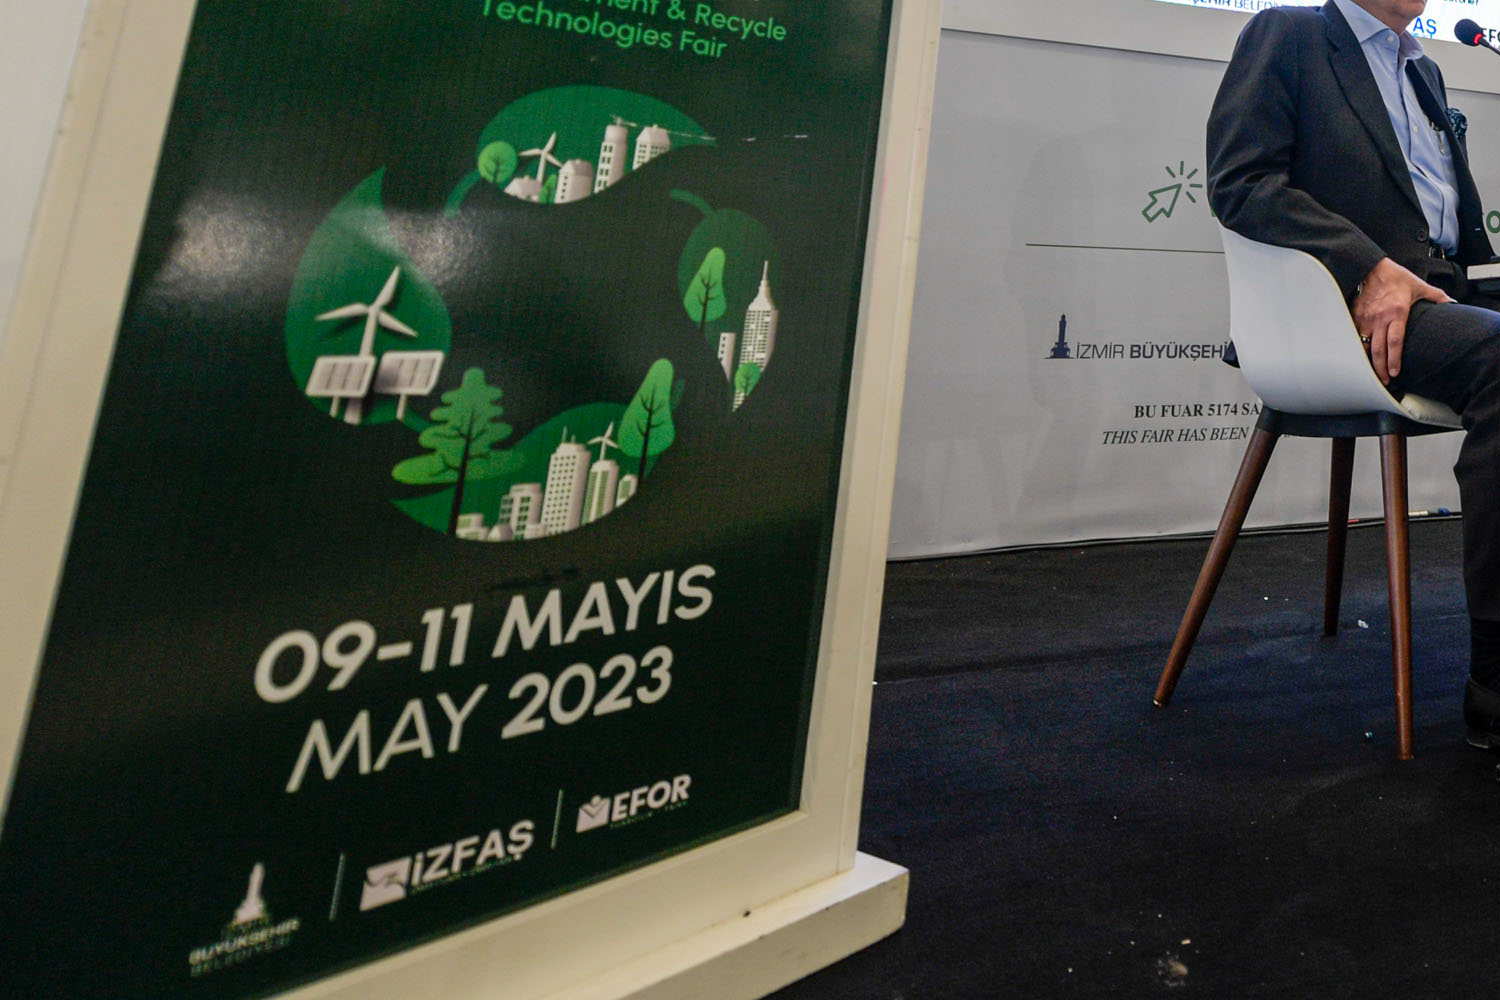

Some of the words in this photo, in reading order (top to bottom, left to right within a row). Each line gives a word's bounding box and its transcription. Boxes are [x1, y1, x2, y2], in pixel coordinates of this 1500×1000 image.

[666, 1, 687, 22] &
[694, 4, 788, 44] Recycle
[679, 30, 728, 60] Fair
[1076, 341, 1125, 360] İZMİR
[1134, 404, 1157, 419] BU
[1160, 403, 1204, 418] FUAR
[1207, 402, 1239, 417] 5174
[1102, 429, 1138, 446] THIS
[1140, 429, 1175, 444] FAIR
[1177, 427, 1208, 443] HAS
[1210, 425, 1250, 441] BEEN
[253, 601, 474, 705] 09-11
[491, 562, 717, 659] MAYIS
[285, 683, 489, 794] MAY
[500, 645, 675, 741] 2023
[610, 773, 693, 823] EFOR
